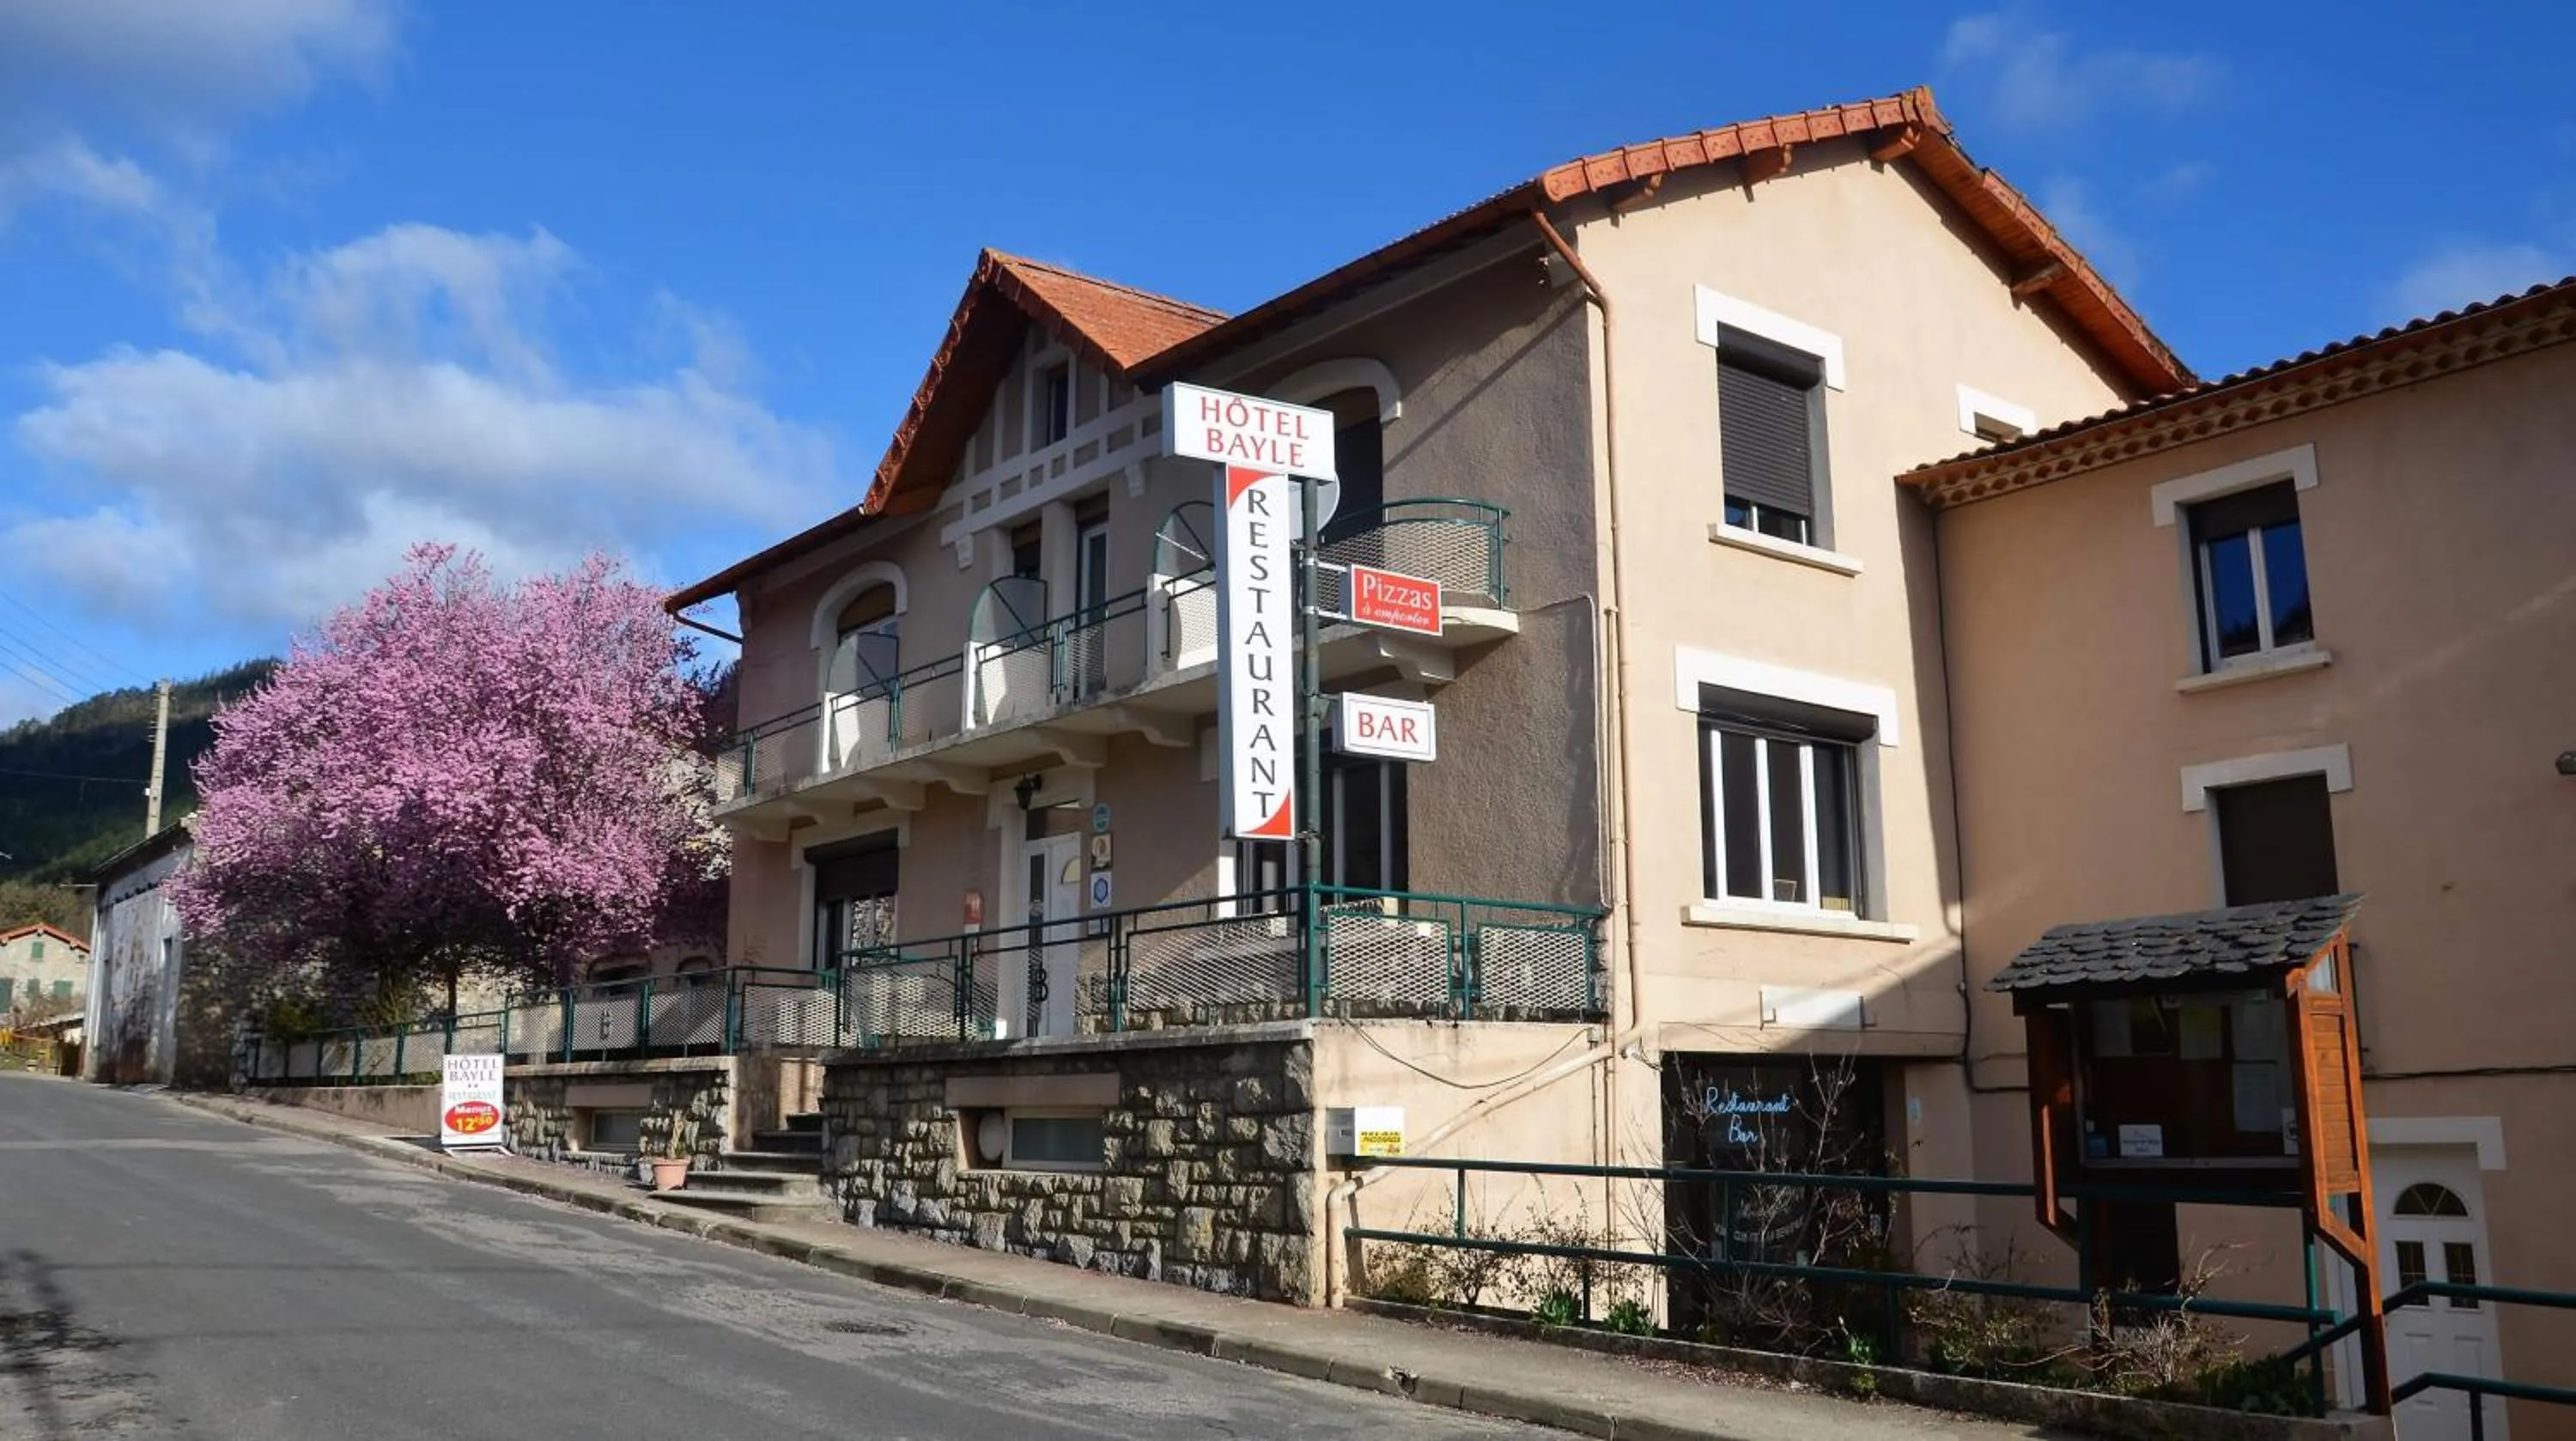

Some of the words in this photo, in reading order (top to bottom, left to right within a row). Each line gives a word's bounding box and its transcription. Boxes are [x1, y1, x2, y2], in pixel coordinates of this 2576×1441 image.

[1200, 397, 1309, 440] HÔTEL
[1207, 428, 1304, 467] BAYLE
[1363, 574, 1432, 611] Pizzas
[1363, 601, 1371, 616] à
[1244, 489, 1276, 818] RESTAURANT
[1358, 711, 1419, 744] BAR
[448, 1056, 499, 1070] HÔTEL
[449, 1071, 495, 1081] BAYLE
[1704, 1086, 1790, 1113] Restaurant
[1728, 1114, 1759, 1142] Bar
